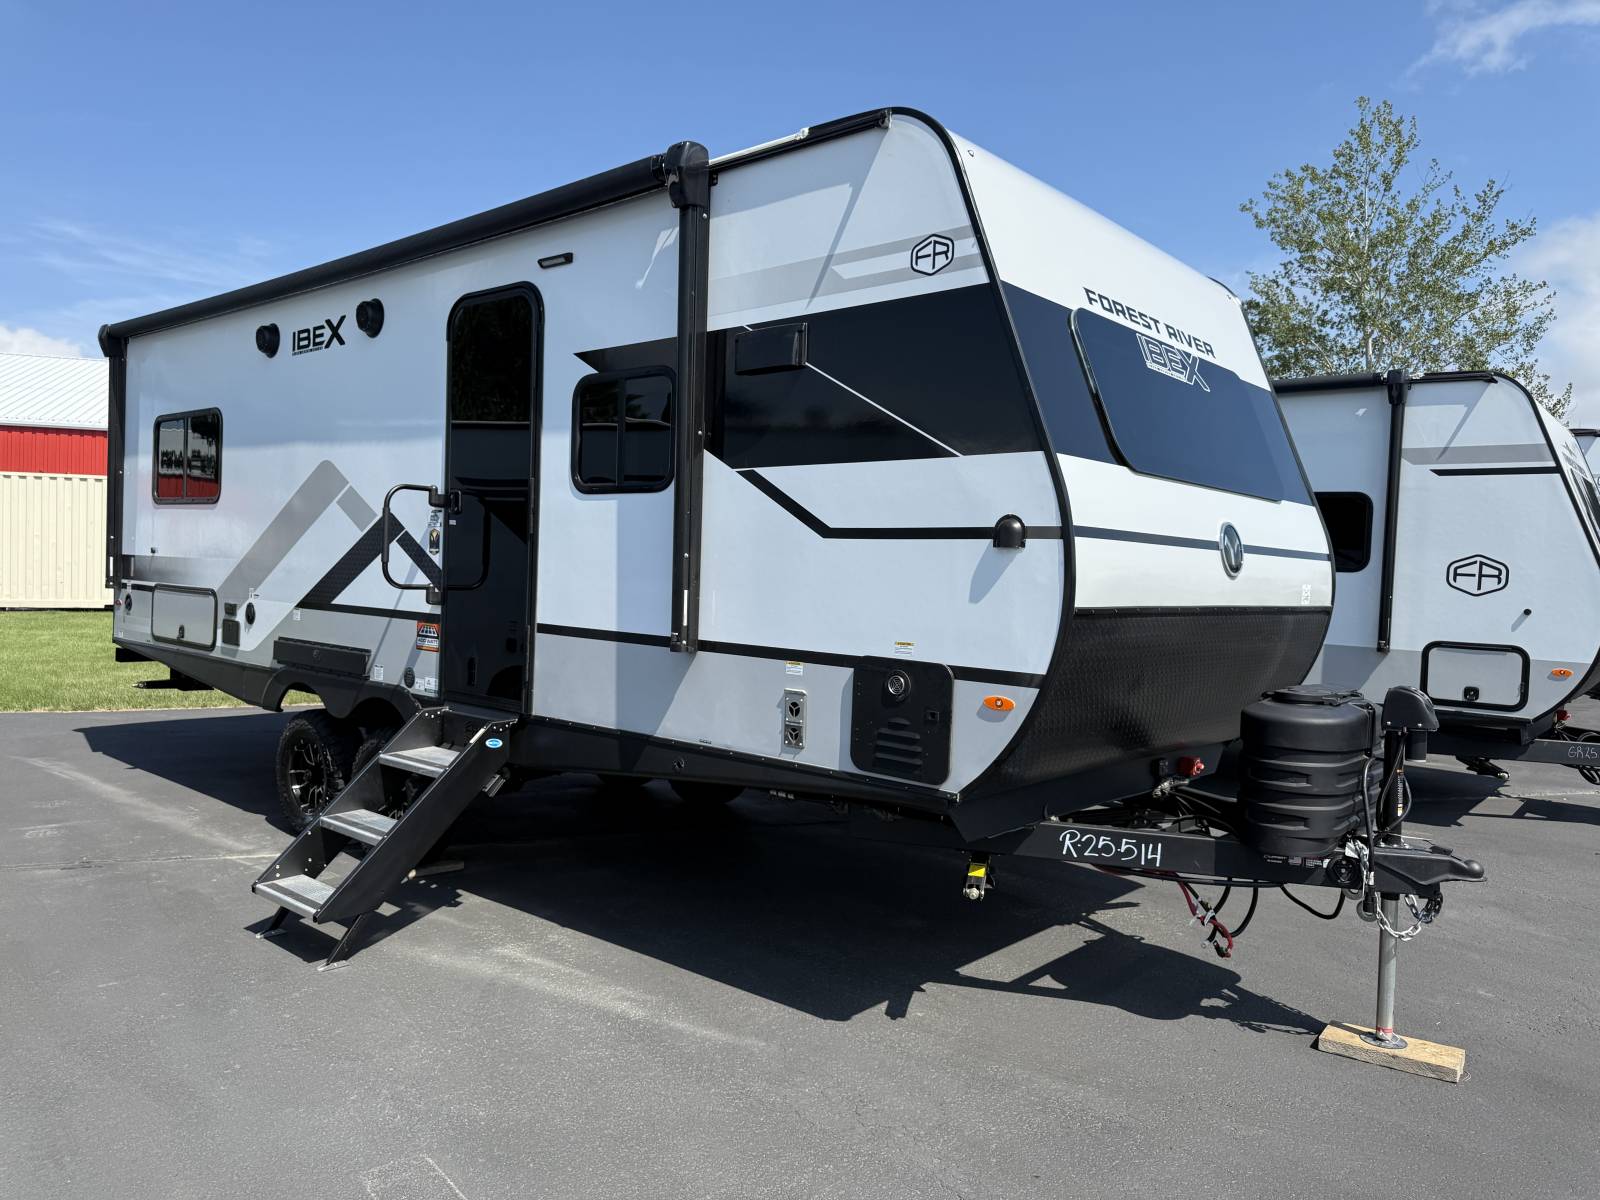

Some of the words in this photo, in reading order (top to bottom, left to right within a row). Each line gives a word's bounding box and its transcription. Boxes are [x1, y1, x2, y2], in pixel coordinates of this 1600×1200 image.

[292, 314, 347, 352] IBEX
[1083, 287, 1161, 334] FOREST
[1163, 322, 1216, 359] RIVER
[1136, 332, 1211, 392] IBEX
